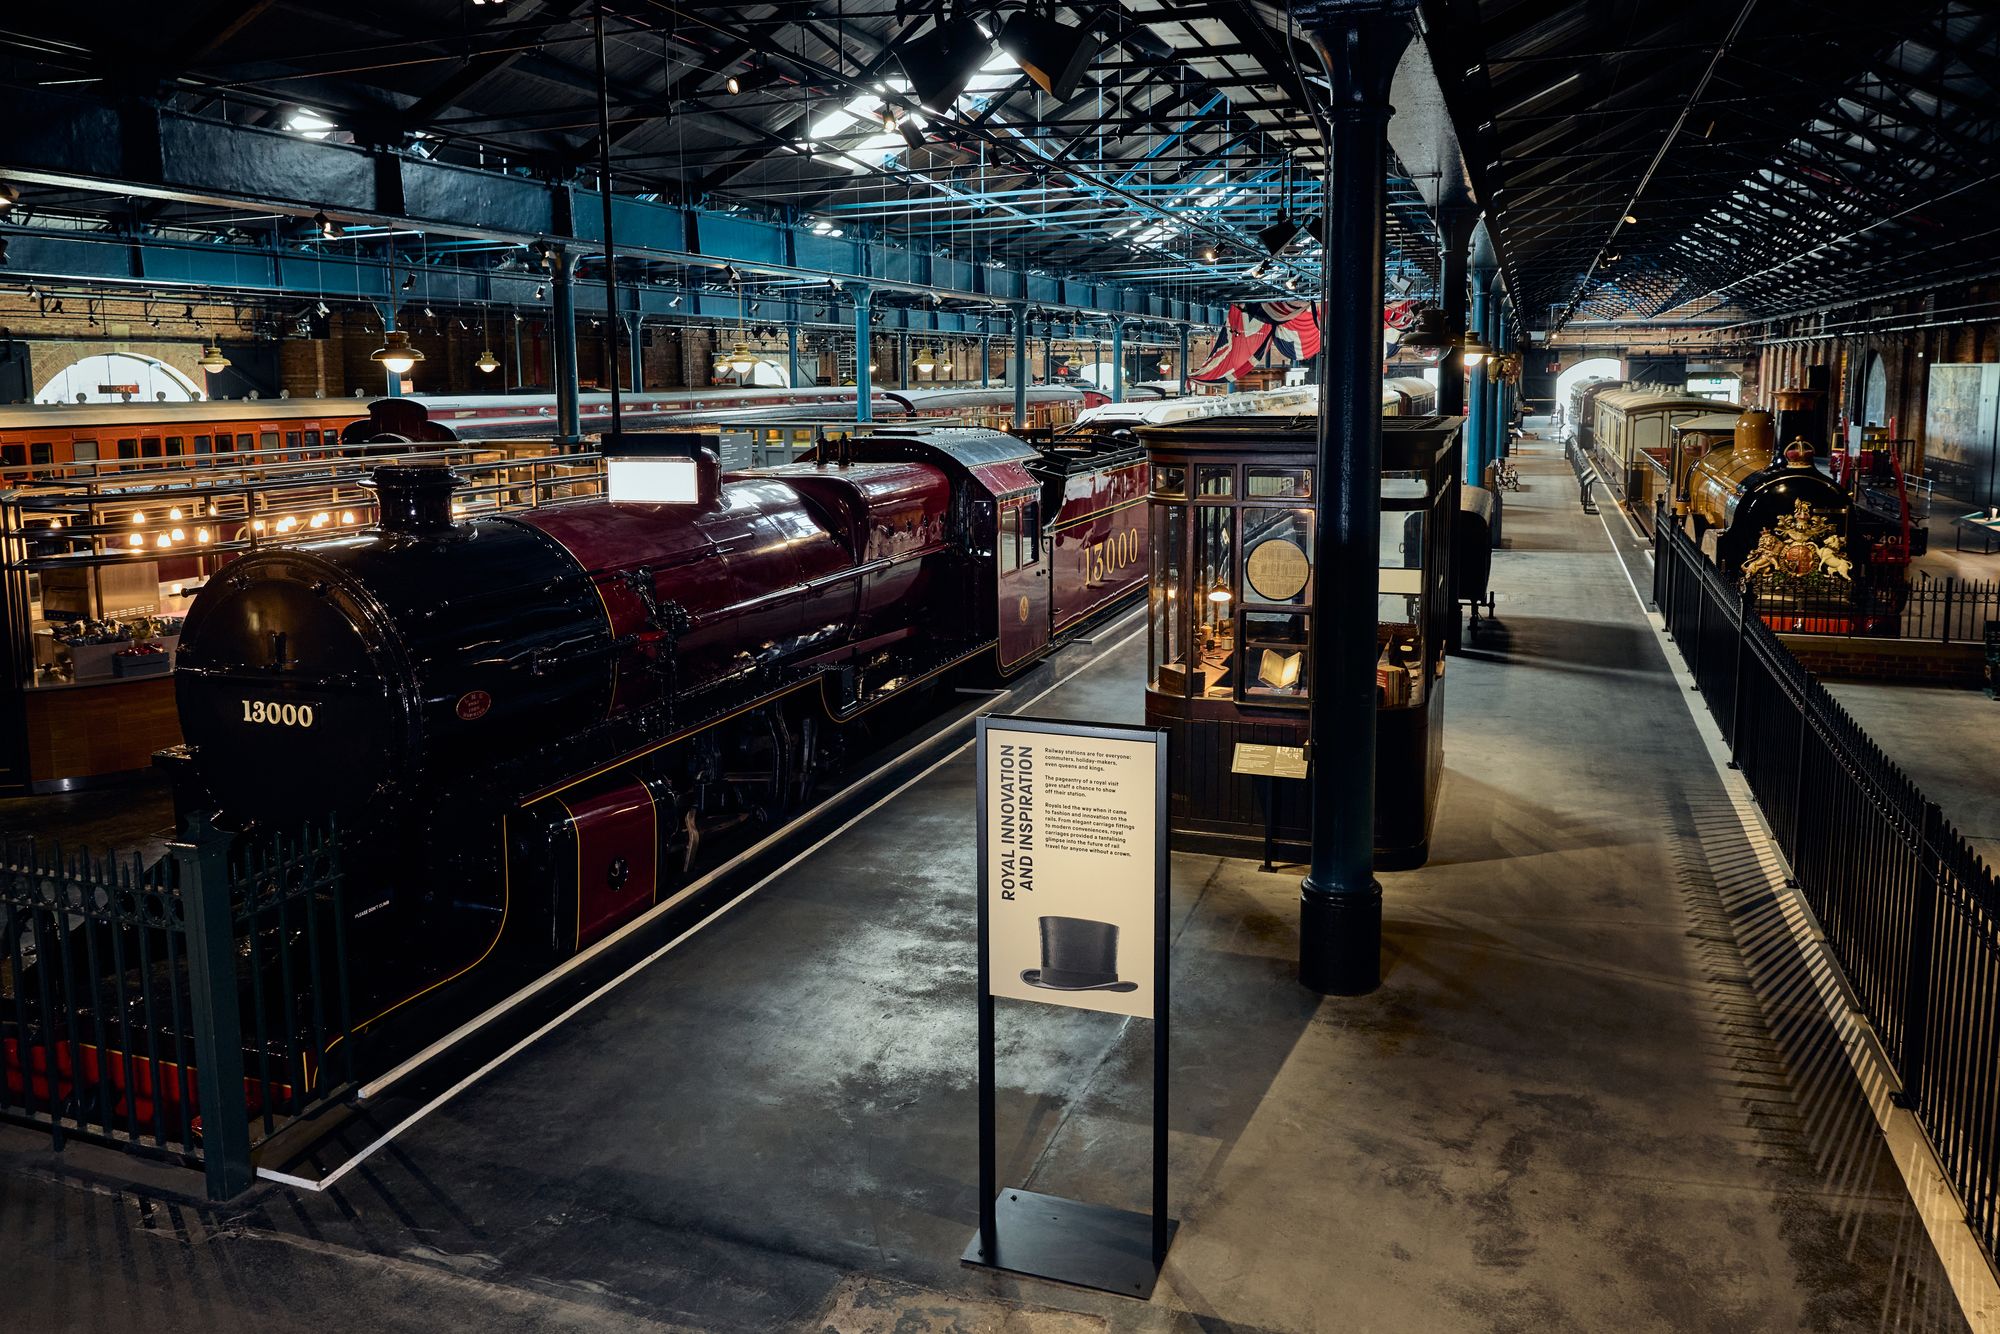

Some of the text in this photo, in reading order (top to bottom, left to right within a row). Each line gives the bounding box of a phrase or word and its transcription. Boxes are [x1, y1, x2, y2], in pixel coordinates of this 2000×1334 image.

[1085, 528, 1138, 586] 13000
[242, 699, 313, 728] 13000
[1000, 744, 1015, 901] ROYAL INNOVATION
[1018, 746, 1033, 891] AND INSPIRATION
